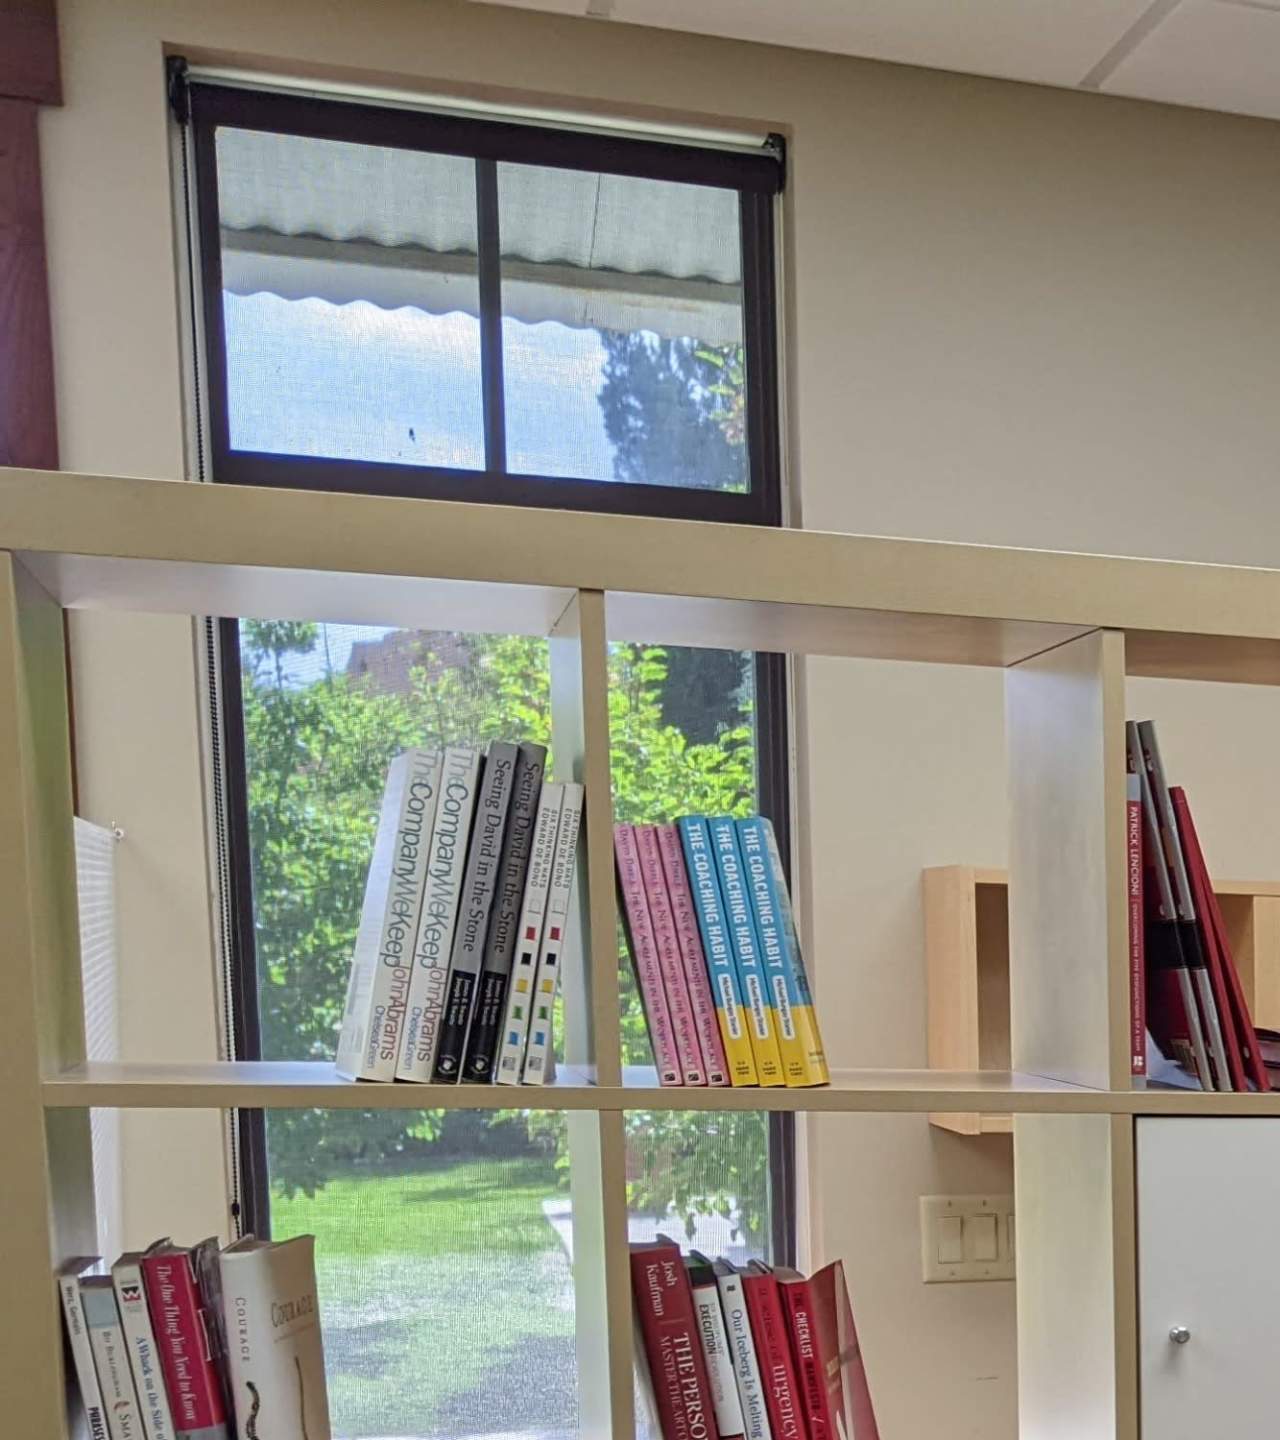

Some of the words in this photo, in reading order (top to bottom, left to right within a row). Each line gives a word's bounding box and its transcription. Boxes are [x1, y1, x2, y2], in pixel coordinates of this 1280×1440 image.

[486, 759, 511, 809] Seeing
[516, 762, 540, 811] Seeing
[480, 813, 502, 857] David
[510, 815, 531, 858] David
[537, 808, 549, 845] EDWARD
[561, 808, 572, 845] EDWARD
[688, 824, 704, 849] THE
[716, 825, 733, 850] THE
[744, 827, 760, 852] THE
[1129, 806, 1138, 845] PATRICK
[536, 847, 543, 858] DE
[559, 848, 566, 858] DE
[477, 862, 493, 876] in
[507, 863, 523, 877] in
[531, 862, 540, 887] BONO
[555, 863, 564, 887] BONO
[1130, 849, 1140, 895] LENCIONI
[472, 880, 489, 903] the
[503, 881, 520, 905] the
[694, 852, 718, 923] COACHING
[722, 855, 746, 924] COACHING
[750, 855, 774, 925] COACHING
[463, 909, 484, 952] Stone
[495, 910, 515, 953] Stone
[708, 926, 728, 968] HABIT
[736, 927, 755, 968] HABIT
[763, 927, 783, 969] HABIT
[158, 1265, 173, 1283] The
[661, 1260, 677, 1286] Josh
[161, 1283, 177, 1303] One
[646, 1264, 666, 1316] Kaufman
[163, 1306, 183, 1335] Thing
[700, 1304, 717, 1355] EXECUTION
[732, 1309, 745, 1333] Our
[795, 1311, 814, 1359] CHECKLIST
[138, 1344, 154, 1376] Whack
[171, 1337, 186, 1353] You
[660, 1336, 678, 1381] MASTER
[673, 1333, 694, 1375] THE
[735, 1335, 753, 1377] Iceberg
[174, 1353, 191, 1380] Need
[145, 1378, 154, 1390] on
[668, 1382, 682, 1407] THE
[745, 1380, 756, 1390] Is
[148, 1392, 160, 1408] the
[181, 1392, 198, 1421] Know
[89, 1407, 105, 1440] PHRASES
[151, 1409, 165, 1431] Side
[673, 1409, 687, 1431] ART
[746, 1394, 763, 1438] Melting
